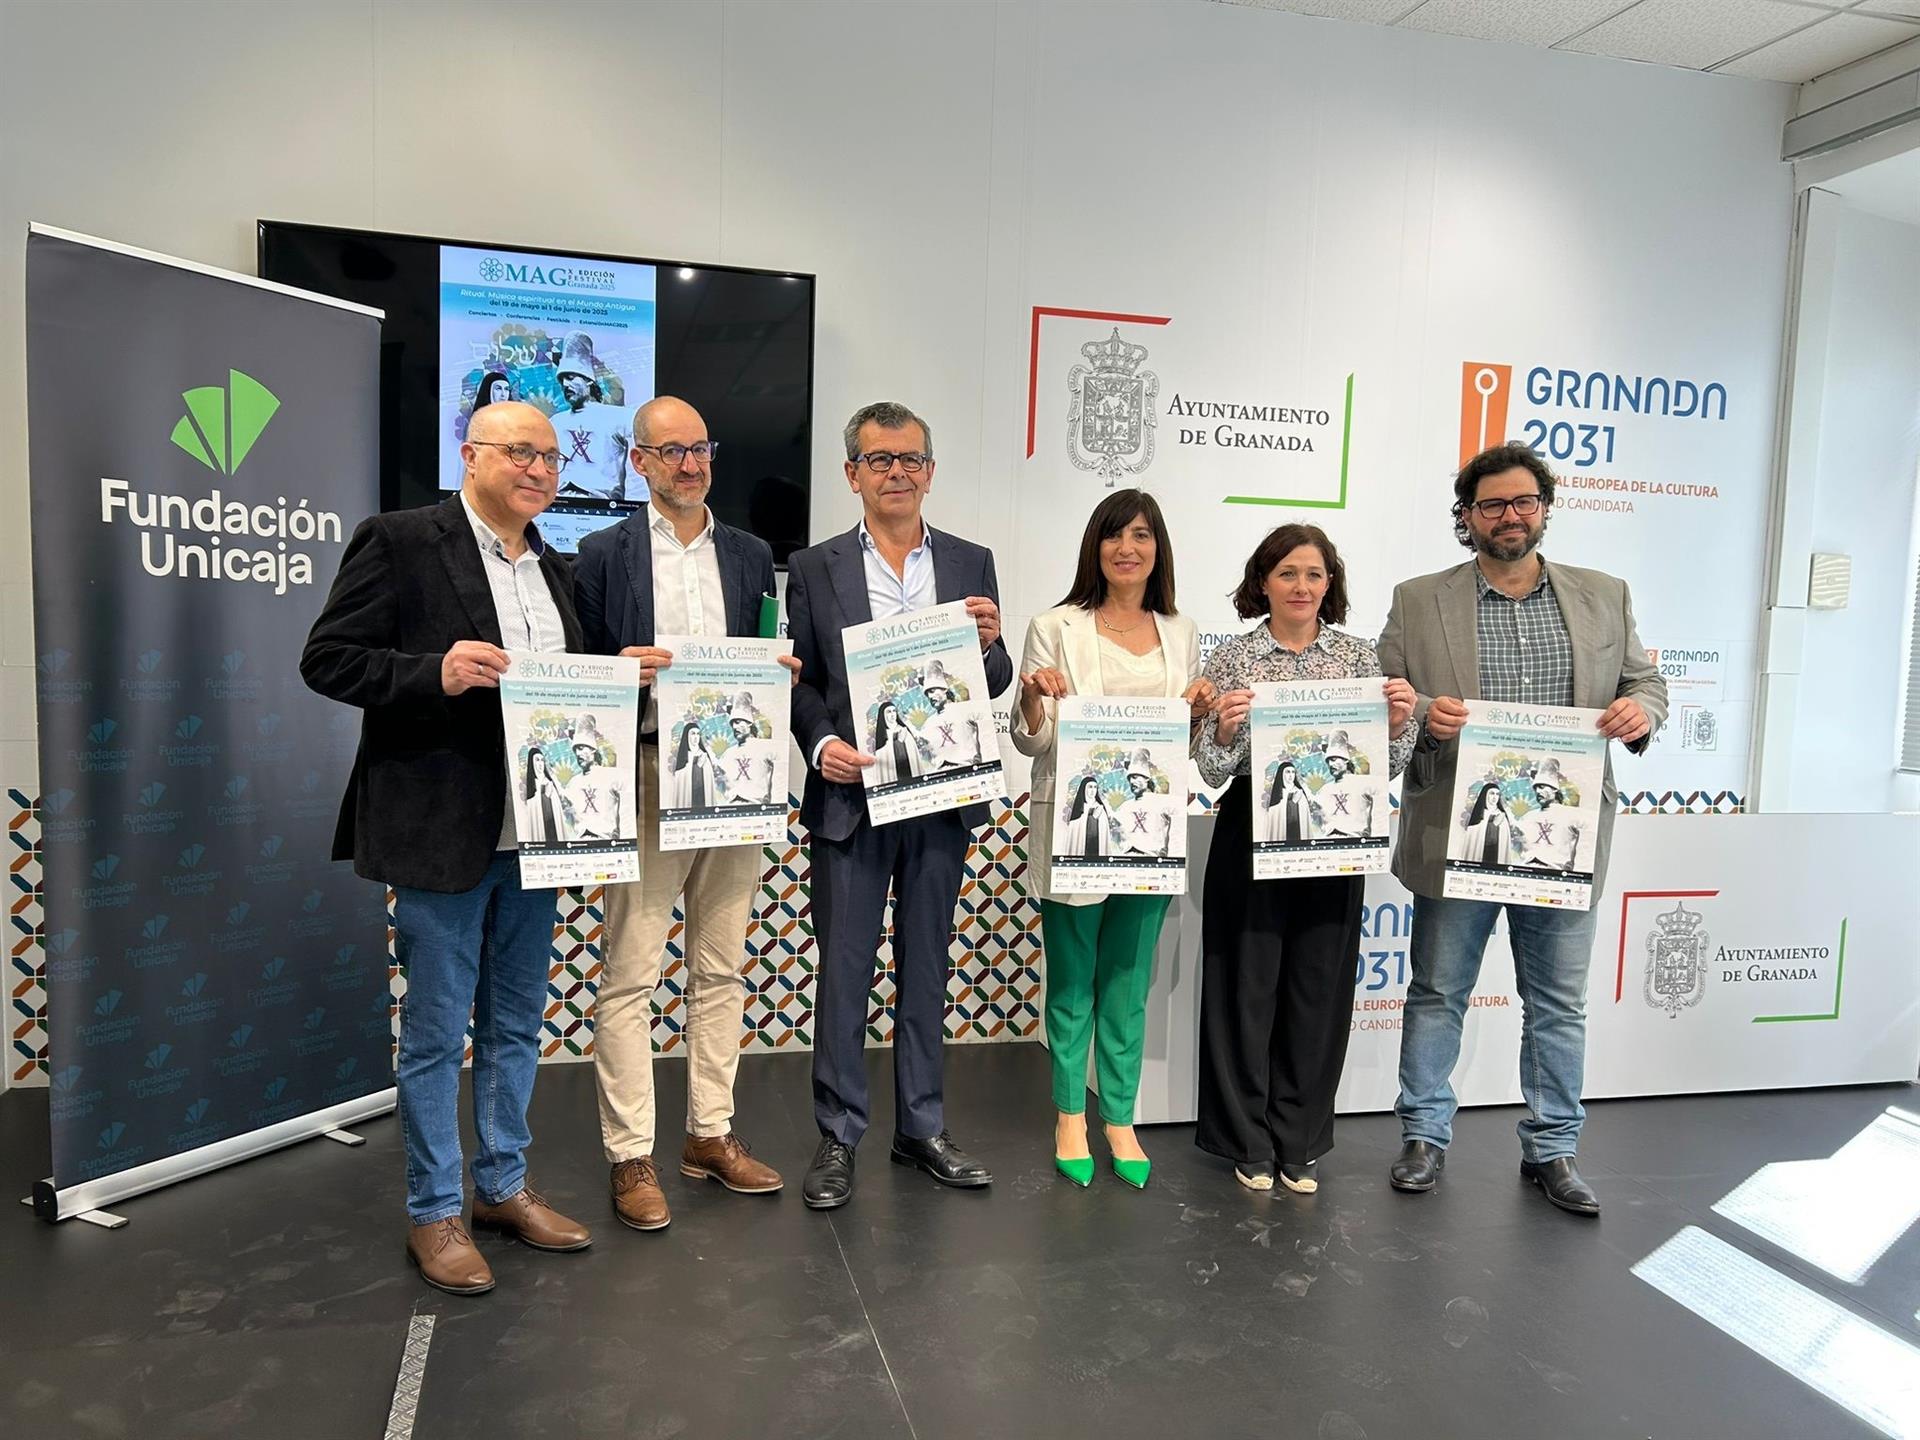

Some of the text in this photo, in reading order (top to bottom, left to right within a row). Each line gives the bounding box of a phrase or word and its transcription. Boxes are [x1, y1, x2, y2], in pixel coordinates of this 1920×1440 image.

[506, 264, 567, 287] MAG
[568, 274, 614, 285] FESTIVAL
[1527, 366, 1727, 420] GRANADA
[1167, 393, 1330, 427] AYUNTAMIENTO
[1214, 425, 1315, 453] GRANADA
[1523, 419, 1615, 467] 2031
[1572, 476, 1628, 492] EUROPEA
[1631, 481, 1646, 493] DE
[1649, 483, 1665, 495] LA
[1666, 483, 1719, 498] CULTURA
[100, 477, 342, 543] Fundación
[1567, 497, 1634, 513] CANDIDATA
[141, 532, 313, 596] Unicaja
[882, 620, 920, 641] MAG
[698, 646, 737, 660] MAG
[1661, 649, 1719, 663] GRANADA
[538, 663, 580, 679] MAG
[1661, 664, 1687, 677] 2031
[1291, 688, 1330, 702] MAG
[1098, 704, 1136, 718] MAG
[1504, 711, 1546, 727] MAG
[1714, 945, 1829, 962] AYUNTAMIENTO
[1747, 964, 1818, 982] GRANADA
